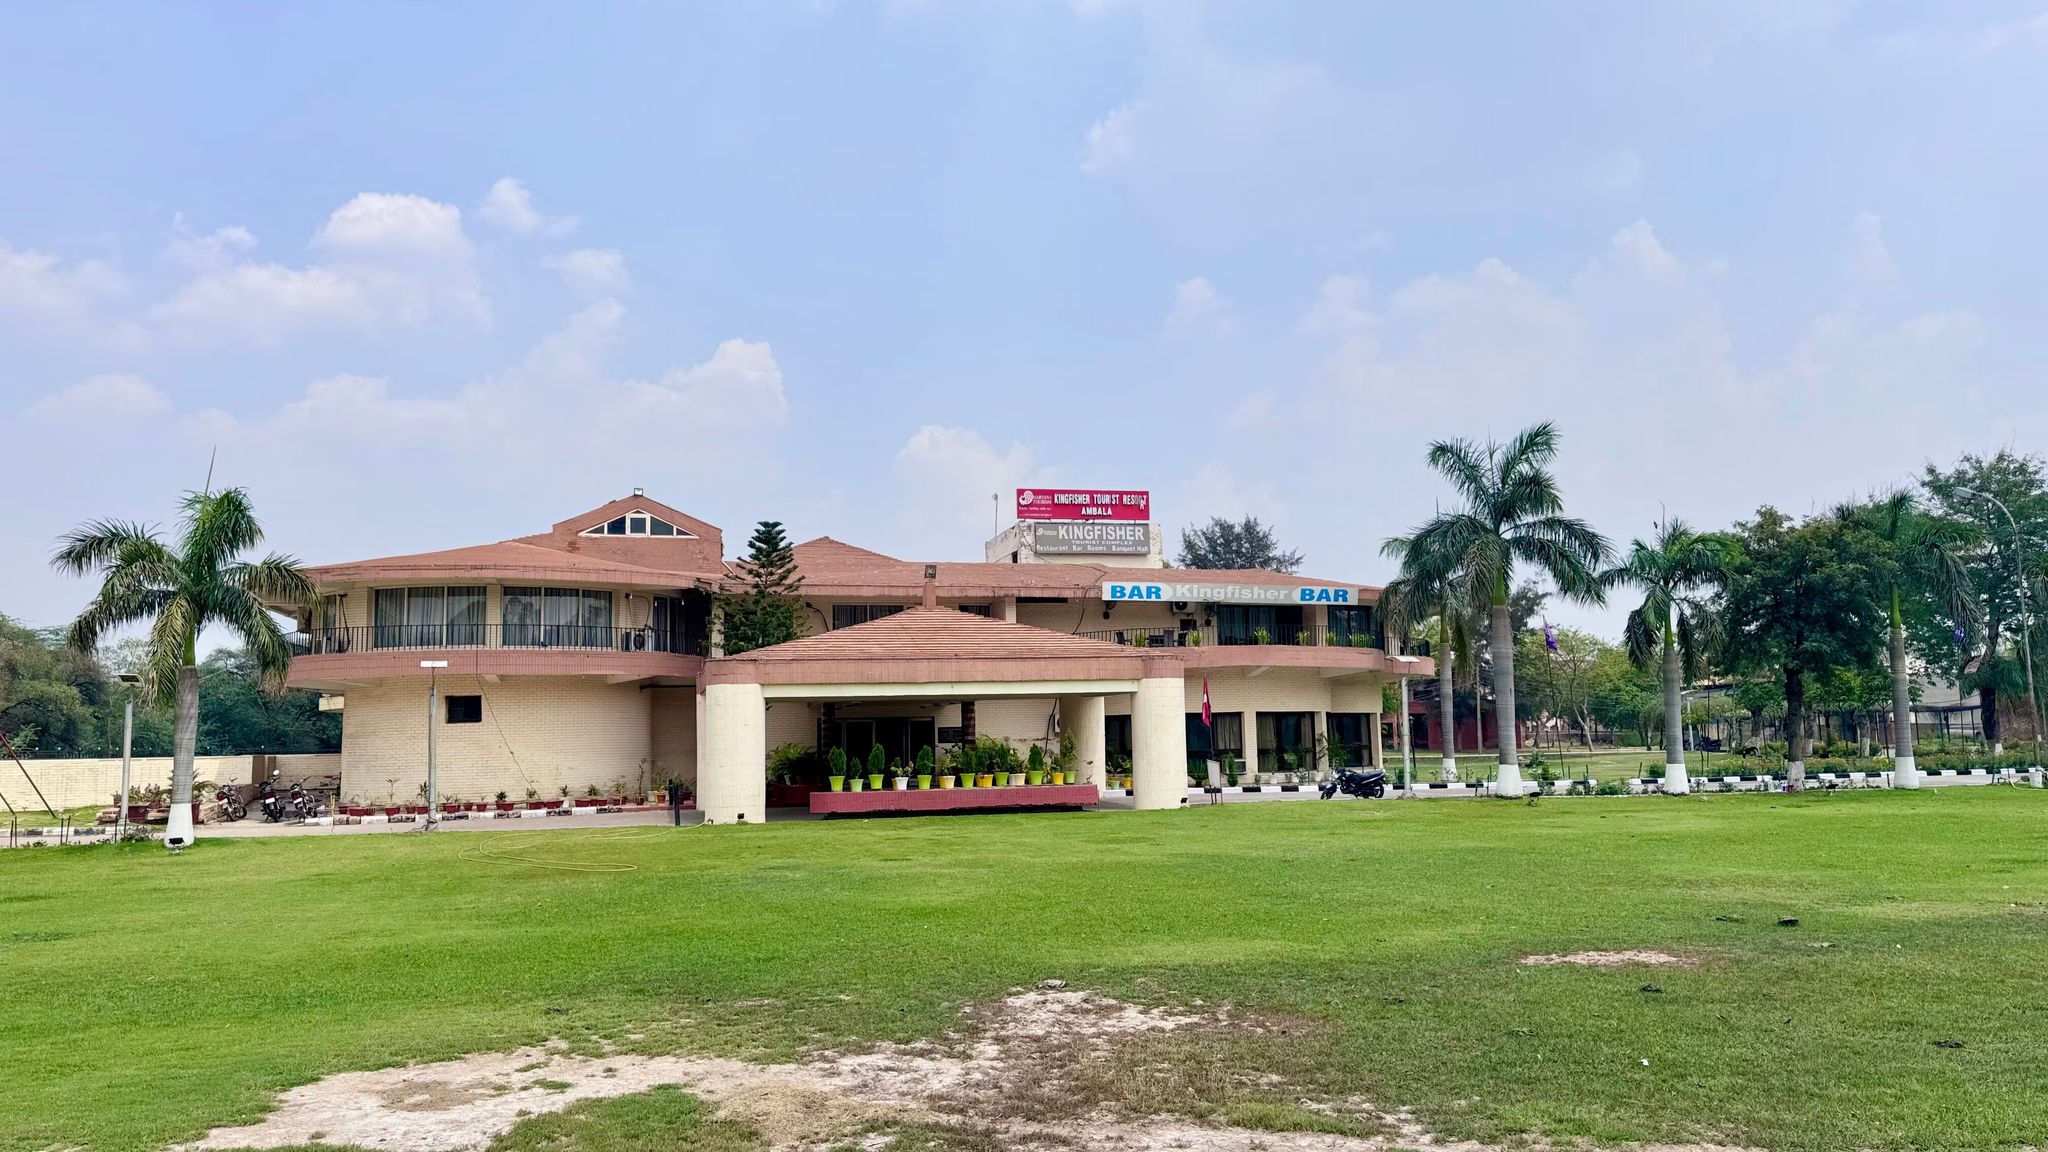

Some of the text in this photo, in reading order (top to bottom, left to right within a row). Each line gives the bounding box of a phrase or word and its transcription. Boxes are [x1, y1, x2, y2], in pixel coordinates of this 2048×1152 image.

[1054, 493, 1091, 505] KINGFISHER
[1093, 494, 1120, 505] TOURIST
[1081, 507, 1113, 516] AMBALA
[1058, 525, 1145, 541] KINGFISHER
[1110, 584, 1349, 603] BAR Kingfisher BAR
